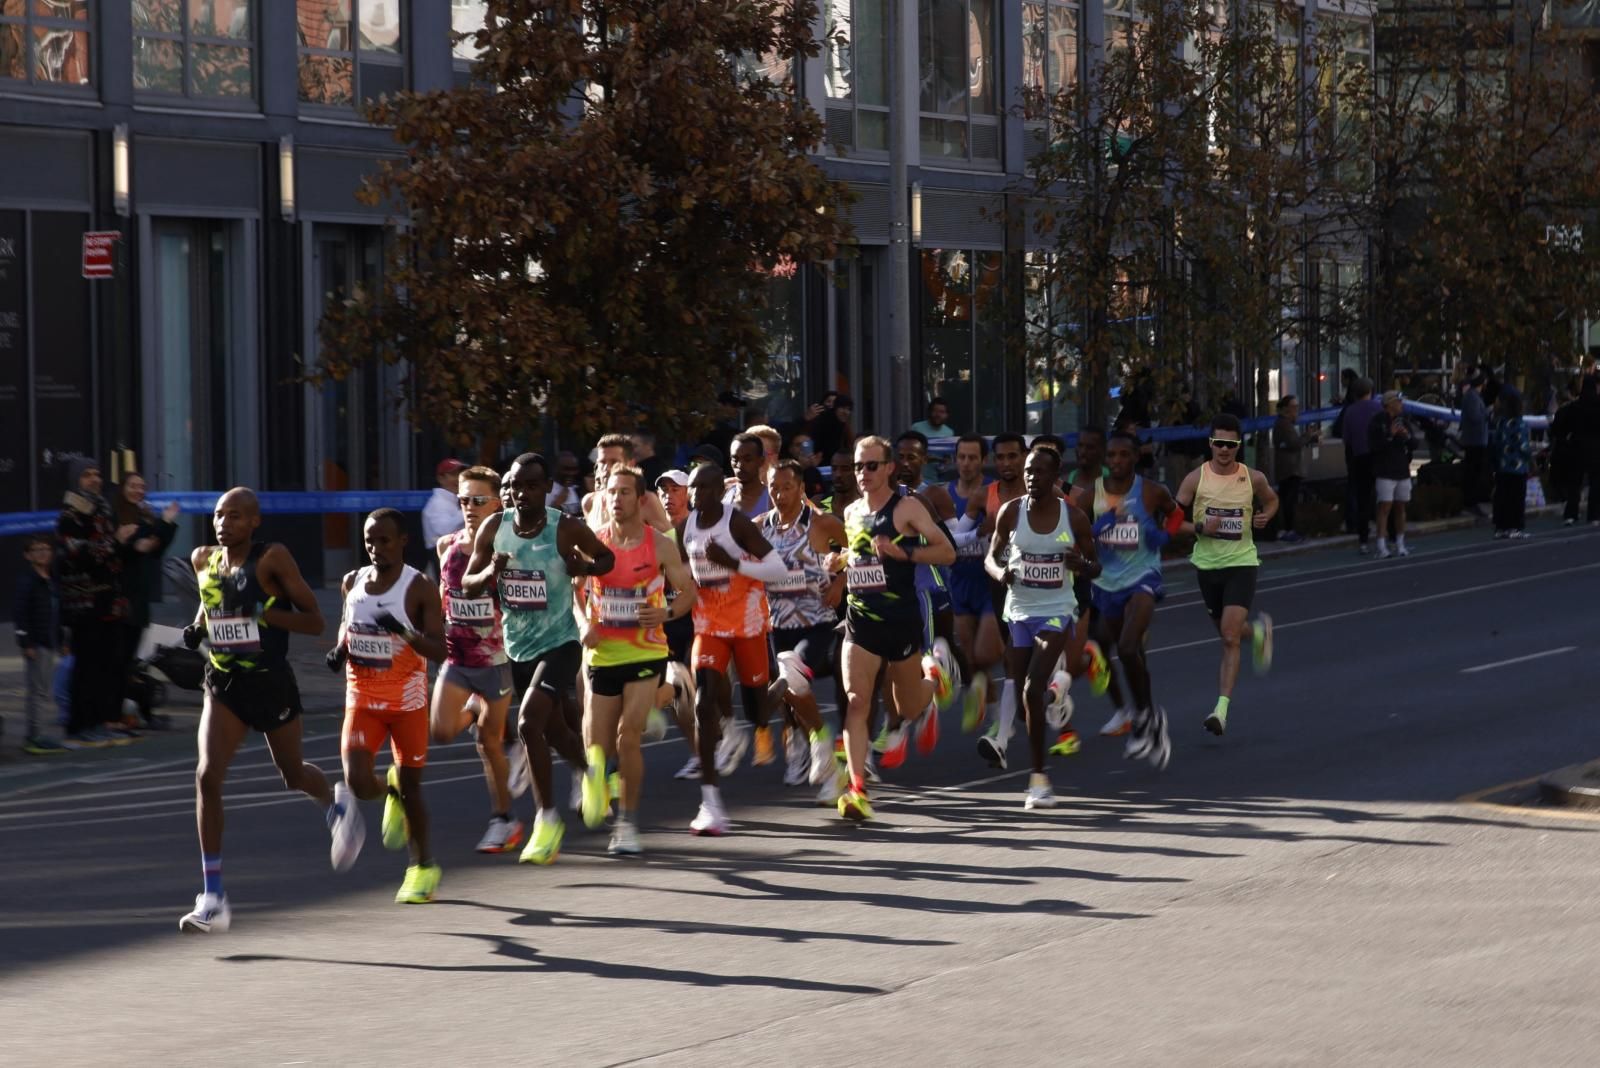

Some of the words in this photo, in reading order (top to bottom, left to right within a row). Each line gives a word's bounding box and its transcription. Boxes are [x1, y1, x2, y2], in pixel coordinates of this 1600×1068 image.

[848, 570, 884, 584] YOUNG
[1025, 565, 1060, 579] KORIR
[453, 602, 491, 617] MANTZ
[214, 623, 250, 640] KIBET
